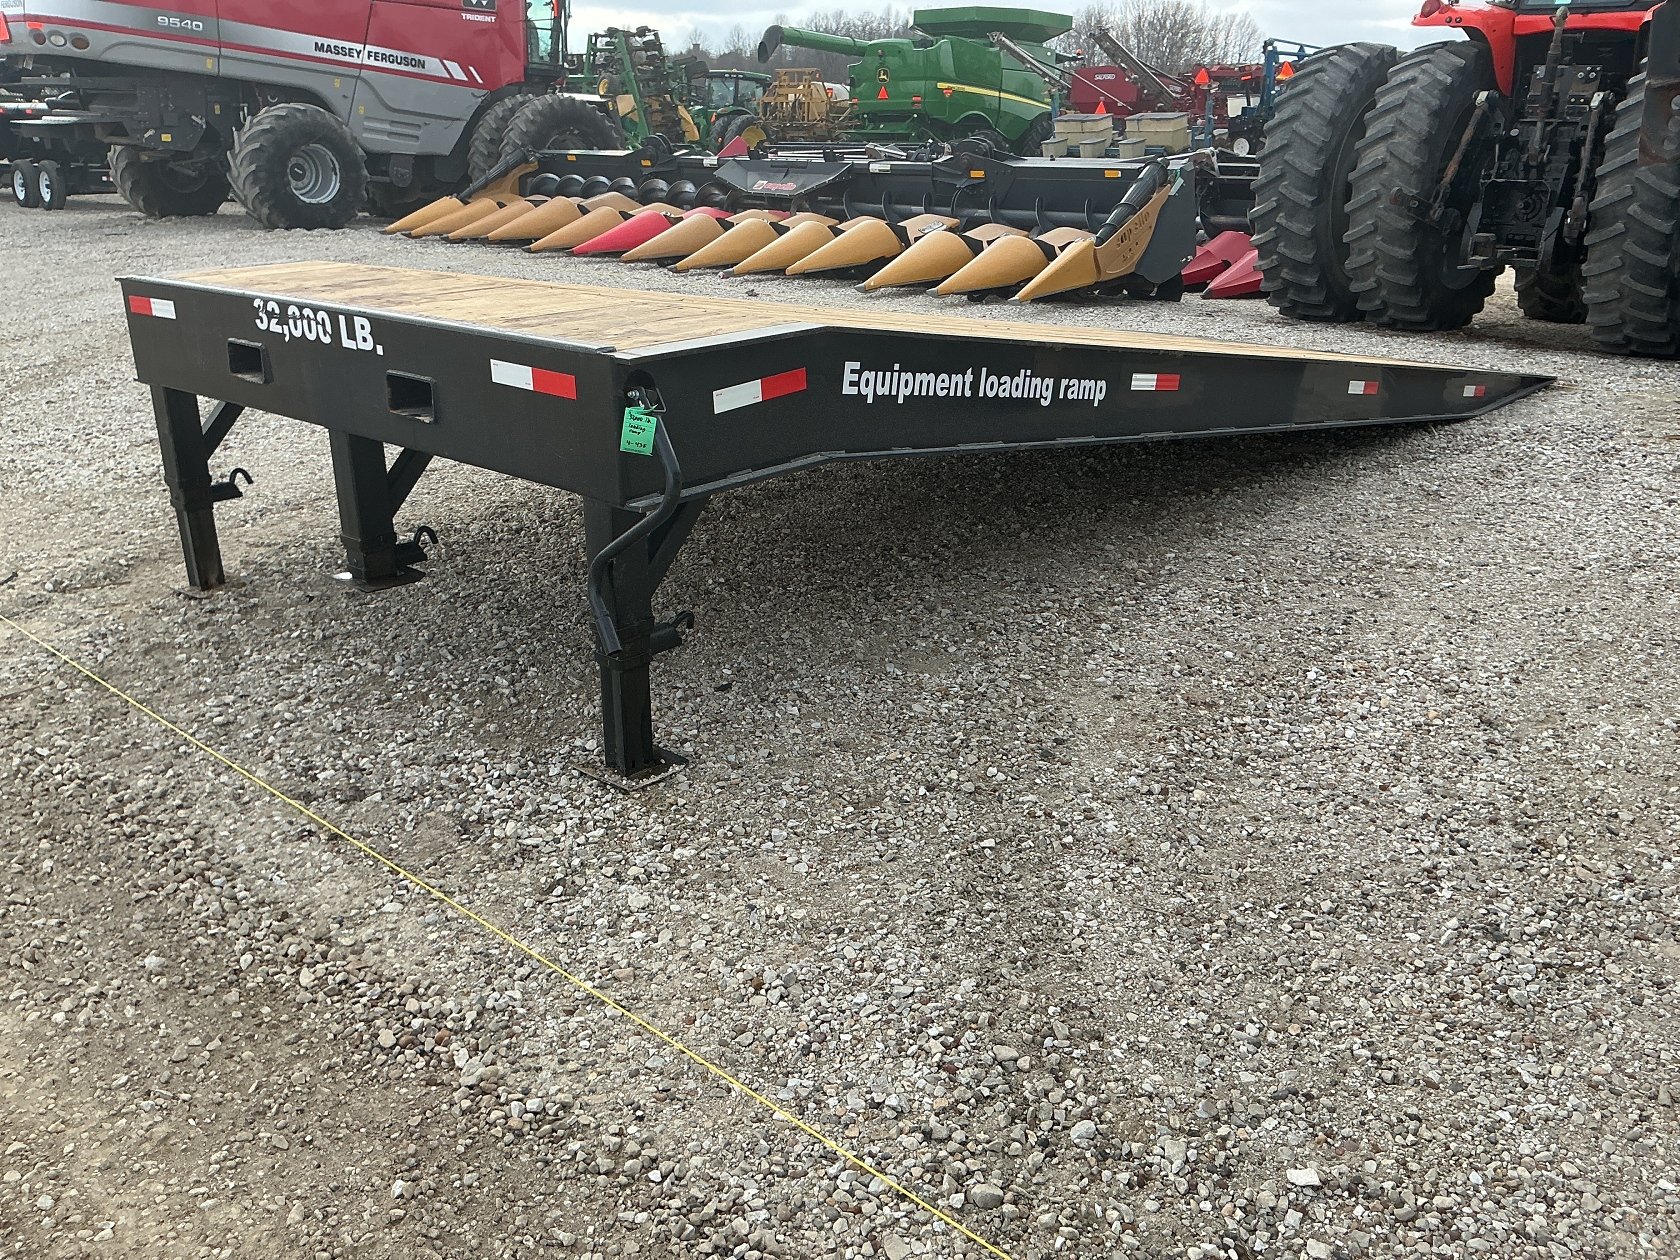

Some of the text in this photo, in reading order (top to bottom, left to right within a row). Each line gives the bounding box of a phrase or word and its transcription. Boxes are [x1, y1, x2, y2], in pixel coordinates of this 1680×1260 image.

[157, 15, 203, 31] 9540
[461, 13, 496, 23] TRIDENT
[314, 41, 426, 70] MASSEY FERGUSON
[253, 298, 384, 355] 32,000 LB.
[842, 361, 1107, 407] Equipment loading ramp
